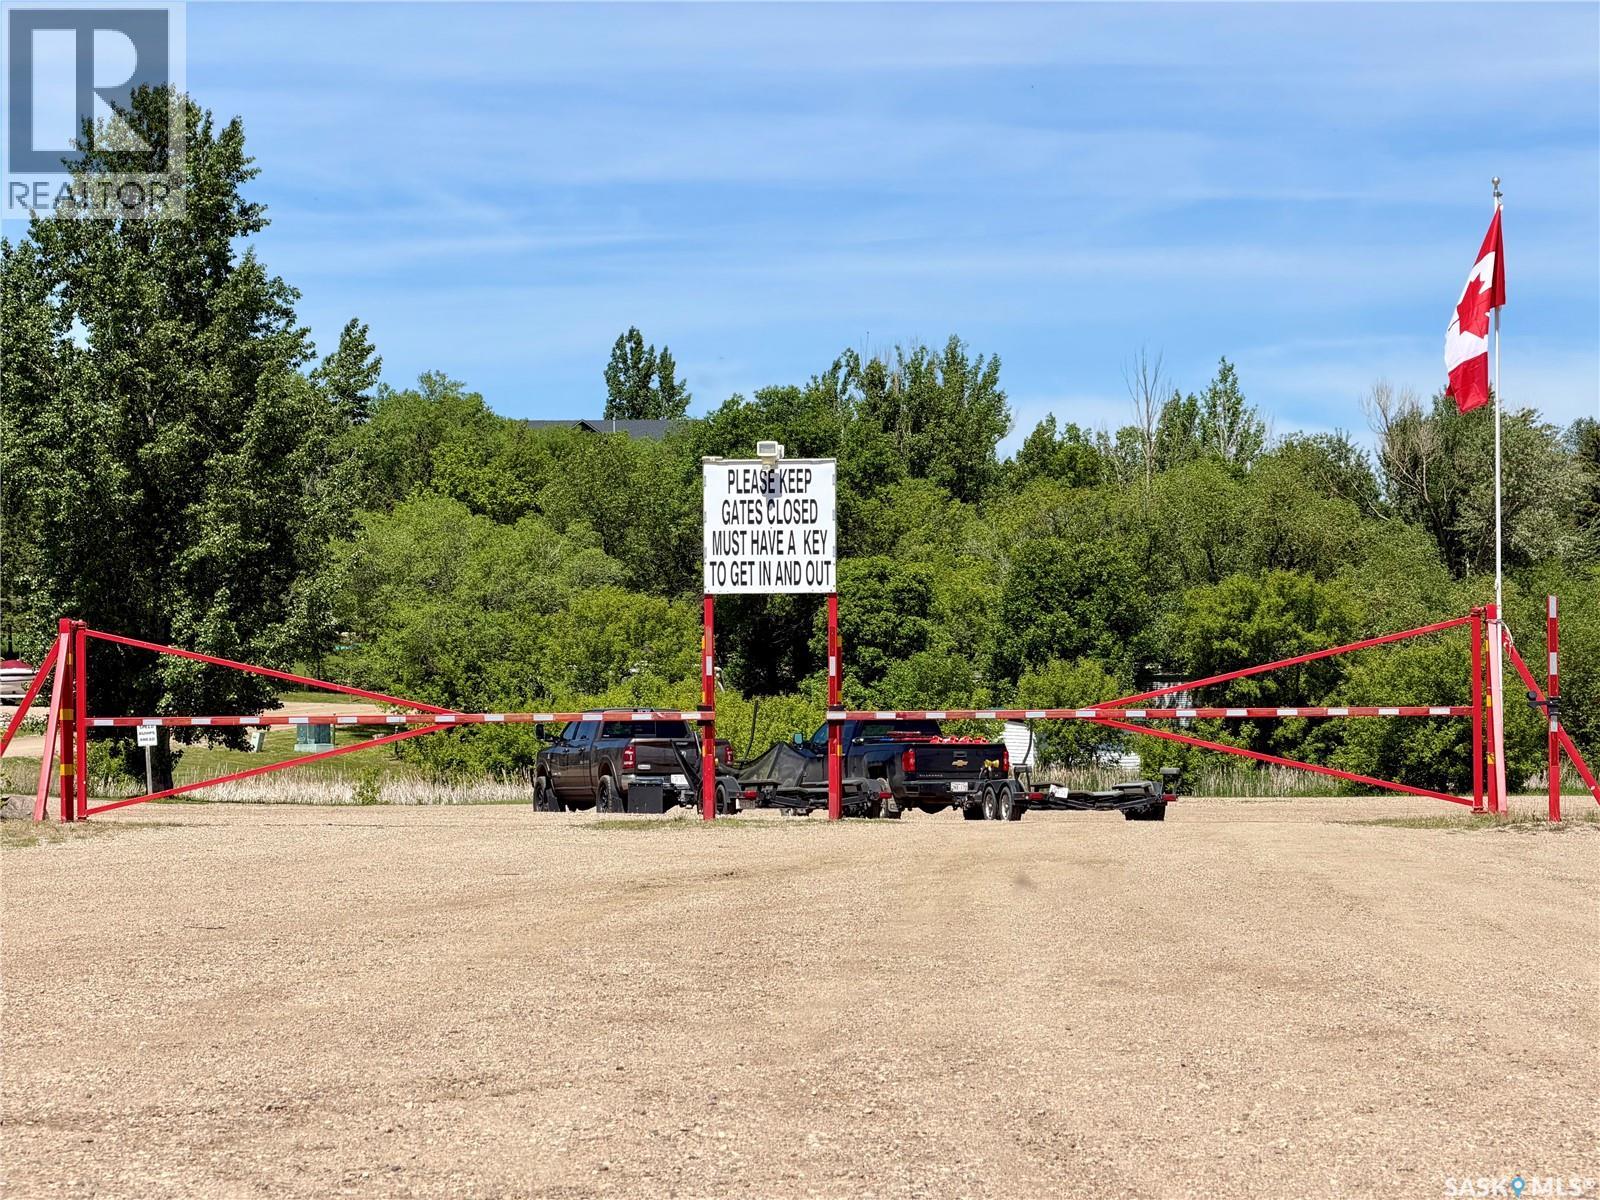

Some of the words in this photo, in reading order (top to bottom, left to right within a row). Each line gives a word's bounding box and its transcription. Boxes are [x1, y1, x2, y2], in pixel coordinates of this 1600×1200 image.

[728, 469, 775, 494] PLEASE
[779, 469, 812, 494] KEEP
[722, 499, 763, 525] GATES
[767, 499, 818, 525] CLOSED
[712, 530, 747, 556] MUST
[751, 530, 784, 556] HAVE
[787, 530, 796, 555] A
[803, 530, 828, 555] KEY
[710, 561, 727, 586] TO
[730, 561, 755, 586] GET
[759, 561, 771, 586] IN
[775, 561, 802, 586] AND
[805, 560, 831, 586] OUT
